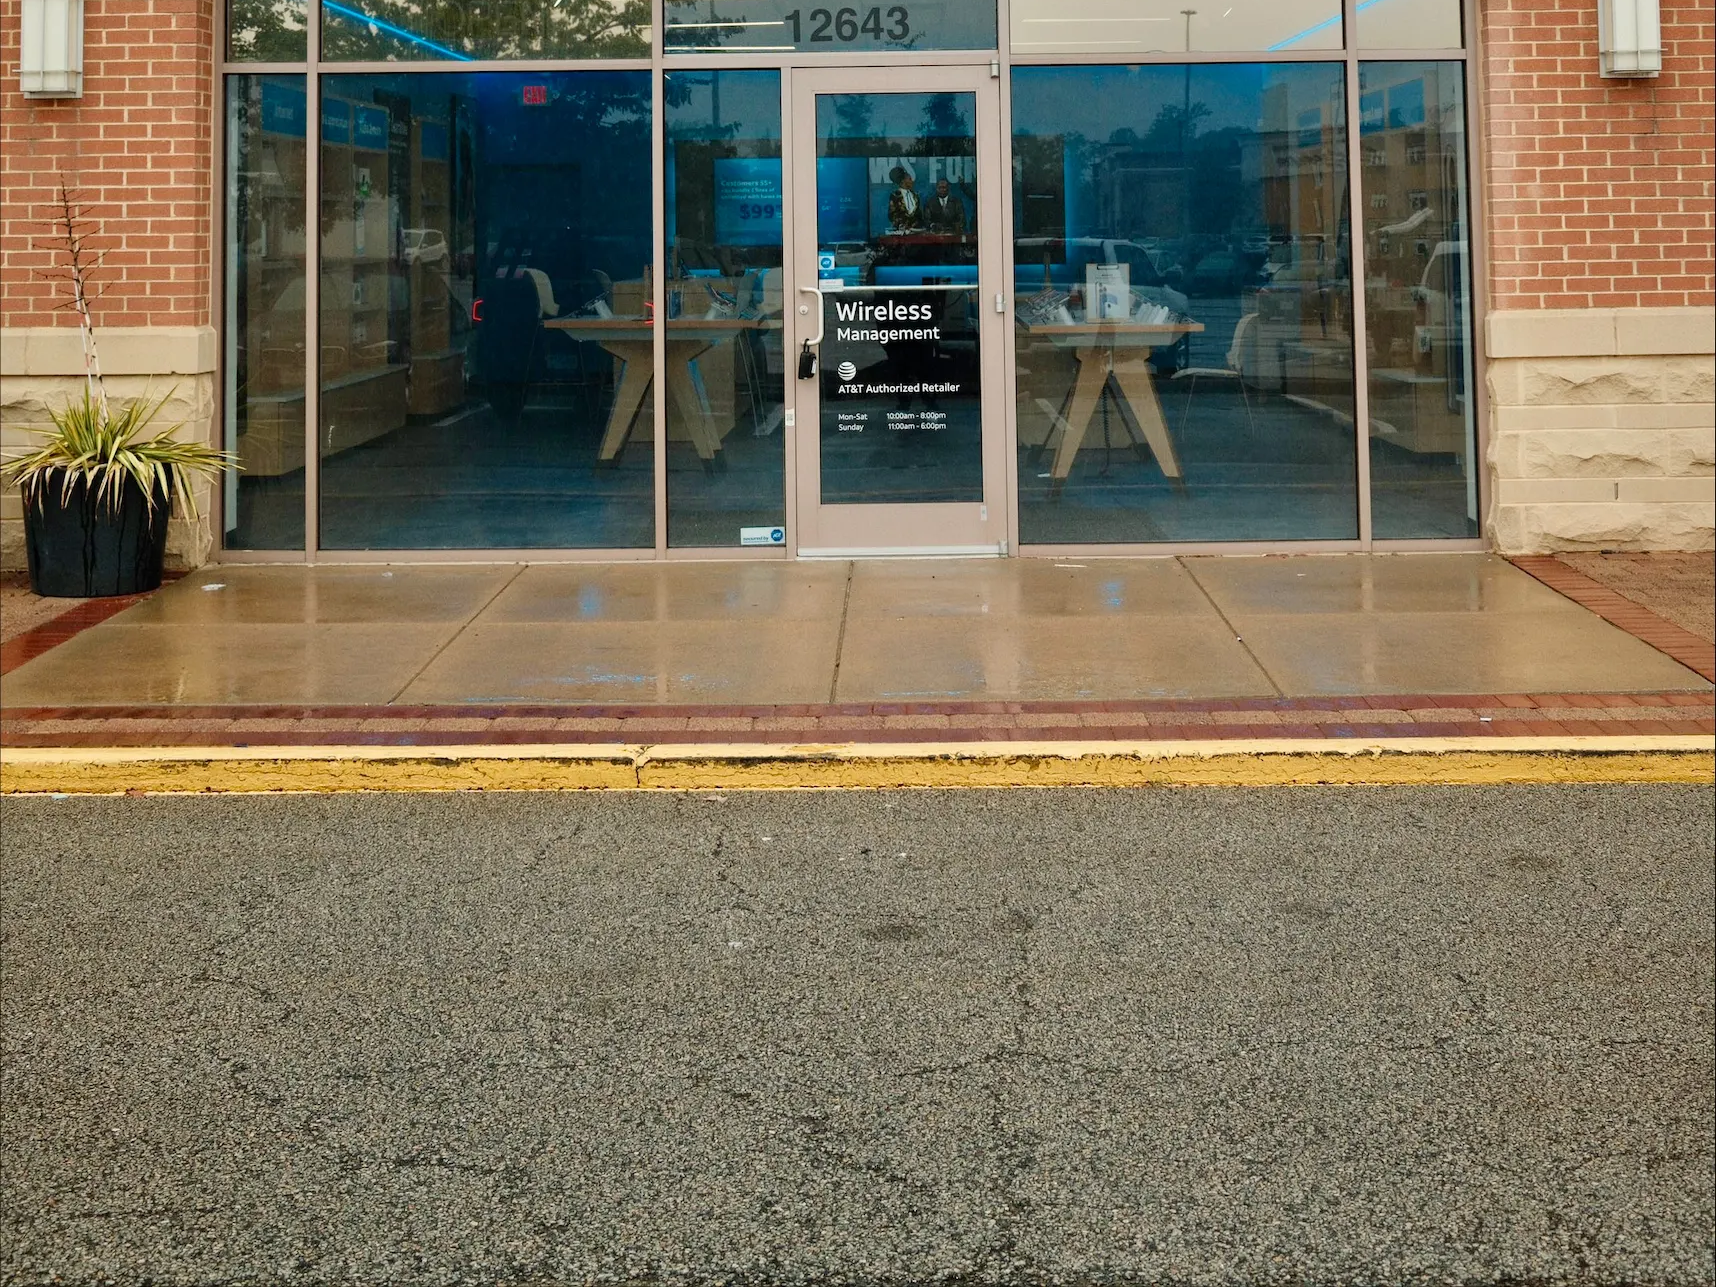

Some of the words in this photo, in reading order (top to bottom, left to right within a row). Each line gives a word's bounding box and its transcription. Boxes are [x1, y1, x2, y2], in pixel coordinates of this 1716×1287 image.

[784, 6, 910, 43] 12643
[523, 85, 547, 104] EXIT
[835, 299, 933, 321] Wireless
[837, 326, 940, 344] Management
[838, 384, 864, 394] AT&T
[865, 383, 921, 394] Authorized
[921, 382, 961, 393] Retailer
[838, 413, 868, 421] Mon-Sat
[886, 412, 915, 420] 10:00am
[920, 412, 947, 421] 8:00pm
[838, 423, 864, 432] Sunday
[920, 422, 947, 431] 6:00pm
